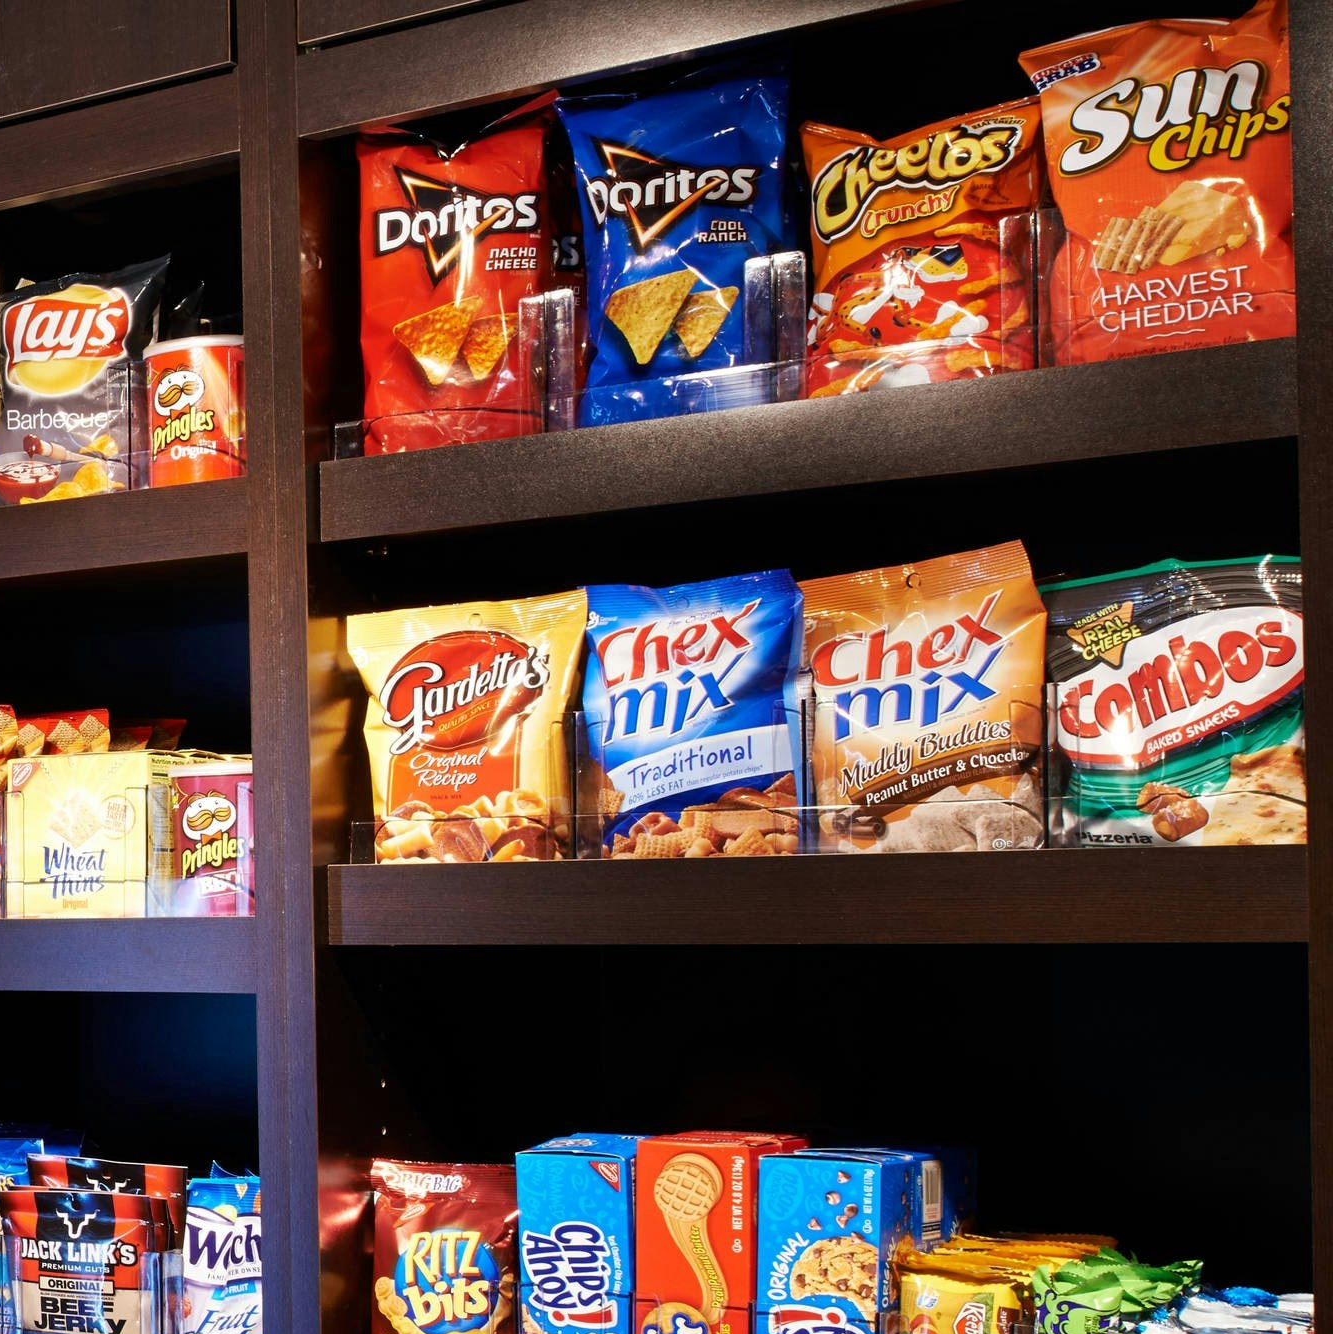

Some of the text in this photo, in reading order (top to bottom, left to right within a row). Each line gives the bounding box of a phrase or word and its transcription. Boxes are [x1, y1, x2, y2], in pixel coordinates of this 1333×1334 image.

[1060, 61, 1265, 176] Sun
[1149, 96, 1290, 171] Chips
[588, 167, 758, 225] Doritos
[816, 128, 1019, 238] Cheetos
[377, 194, 539, 252] Doritos
[710, 220, 744, 231] COOL
[863, 186, 958, 236] Crunchy
[490, 247, 536, 258] NACHO
[698, 230, 746, 242] RANCH
[485, 258, 536, 270] CHEESE
[1099, 264, 1248, 308] HARVEST
[1099, 291, 1254, 333] CHEDDAR
[6, 410, 108, 430] Barbecue
[597, 598, 761, 688] Chex
[814, 588, 1005, 688] Chex
[1082, 625, 1141, 662] CHEESE
[1147, 706, 1240, 754] BAKED SNACKS
[409, 746, 487, 775] Original
[417, 768, 477, 792] Recipe
[627, 736, 753, 790] Traditional
[840, 743, 912, 797] Muddy
[915, 721, 1012, 761] Buddies
[866, 780, 908, 807] Peanut
[911, 765, 952, 788] Butter
[956, 760, 966, 772] &
[21, 1238, 137, 1265] JACK LINK'S
[41, 1262, 110, 1274] PREMIUM CUTS
[405, 1231, 481, 1284] RITZ
[41, 1297, 114, 1316] BEEF
[47, 1278, 104, 1292] ORIGINAL
[403, 1277, 490, 1327] bits
